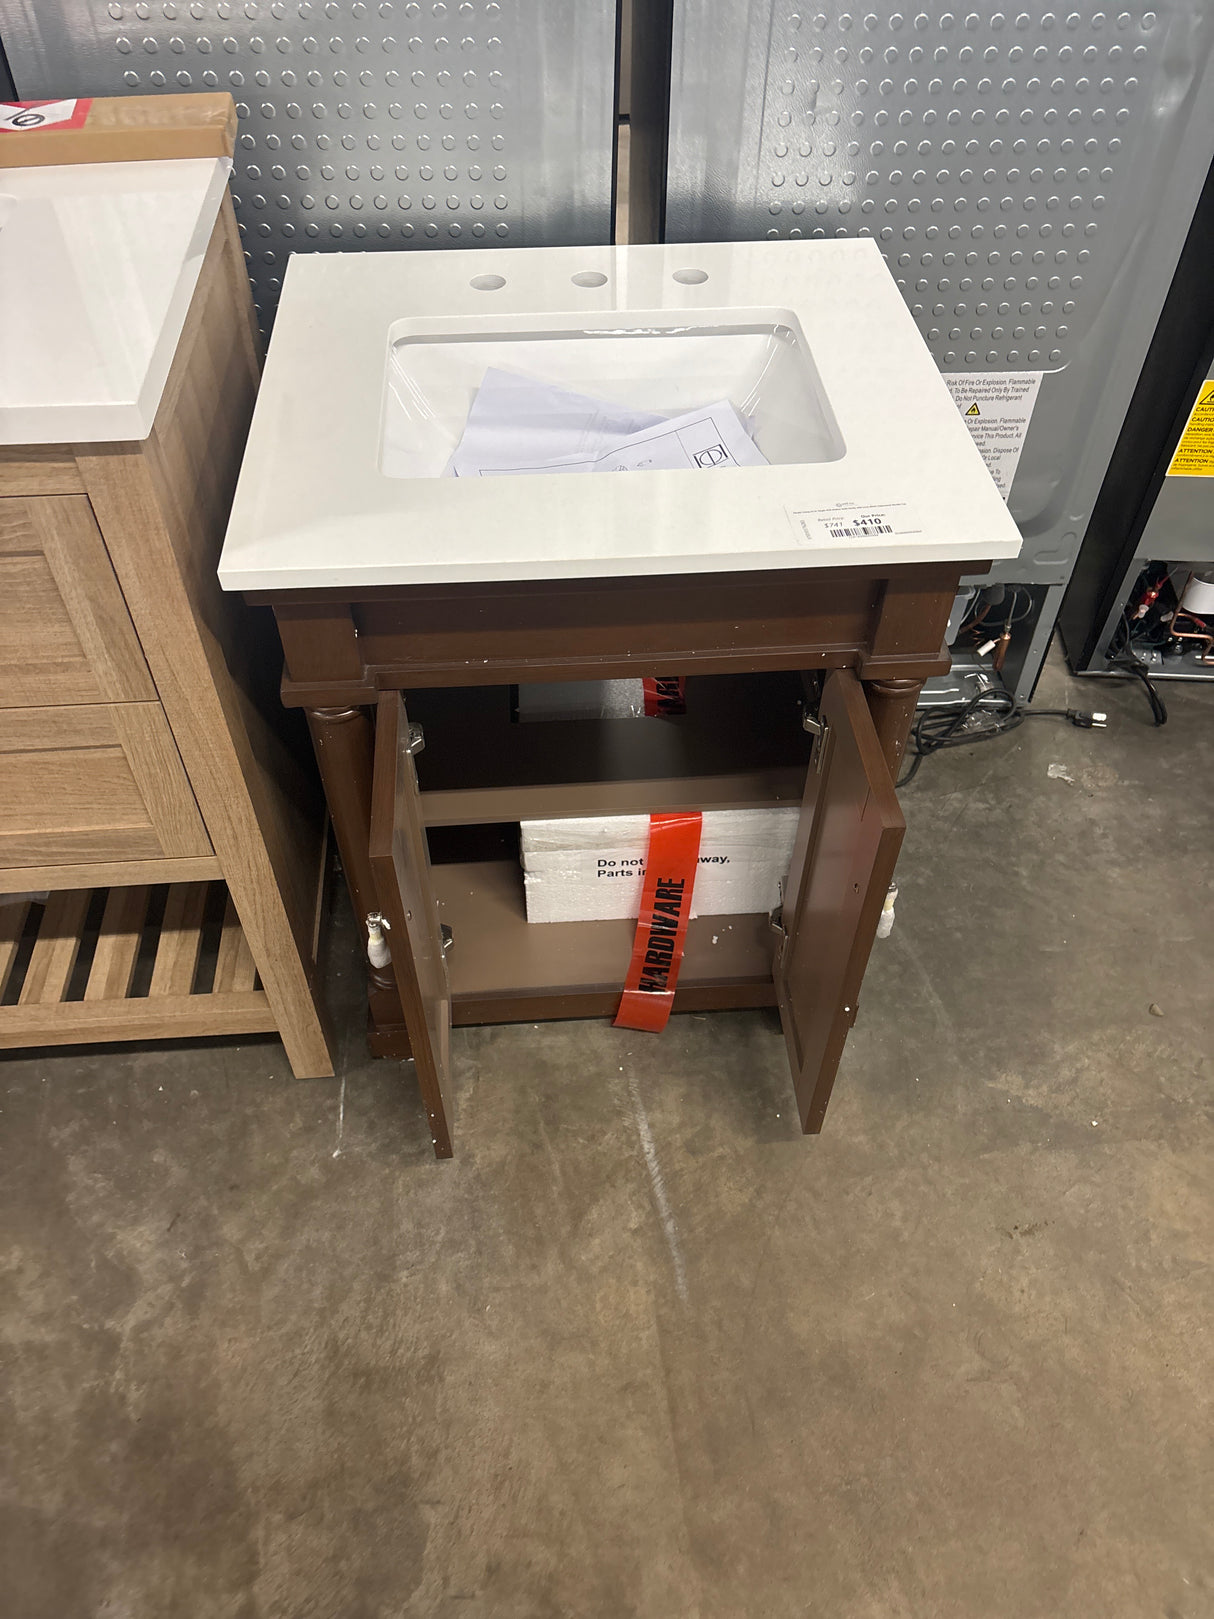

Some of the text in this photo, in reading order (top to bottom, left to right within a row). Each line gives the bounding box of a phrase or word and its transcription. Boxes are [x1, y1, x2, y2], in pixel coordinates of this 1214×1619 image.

[824, 521, 843, 529] $741
[852, 518, 882, 527] $410
[597, 859, 616, 867] Do
[621, 858, 644, 867] not
[597, 869, 633, 877] Parts
[639, 878, 685, 992] HARDWARE
